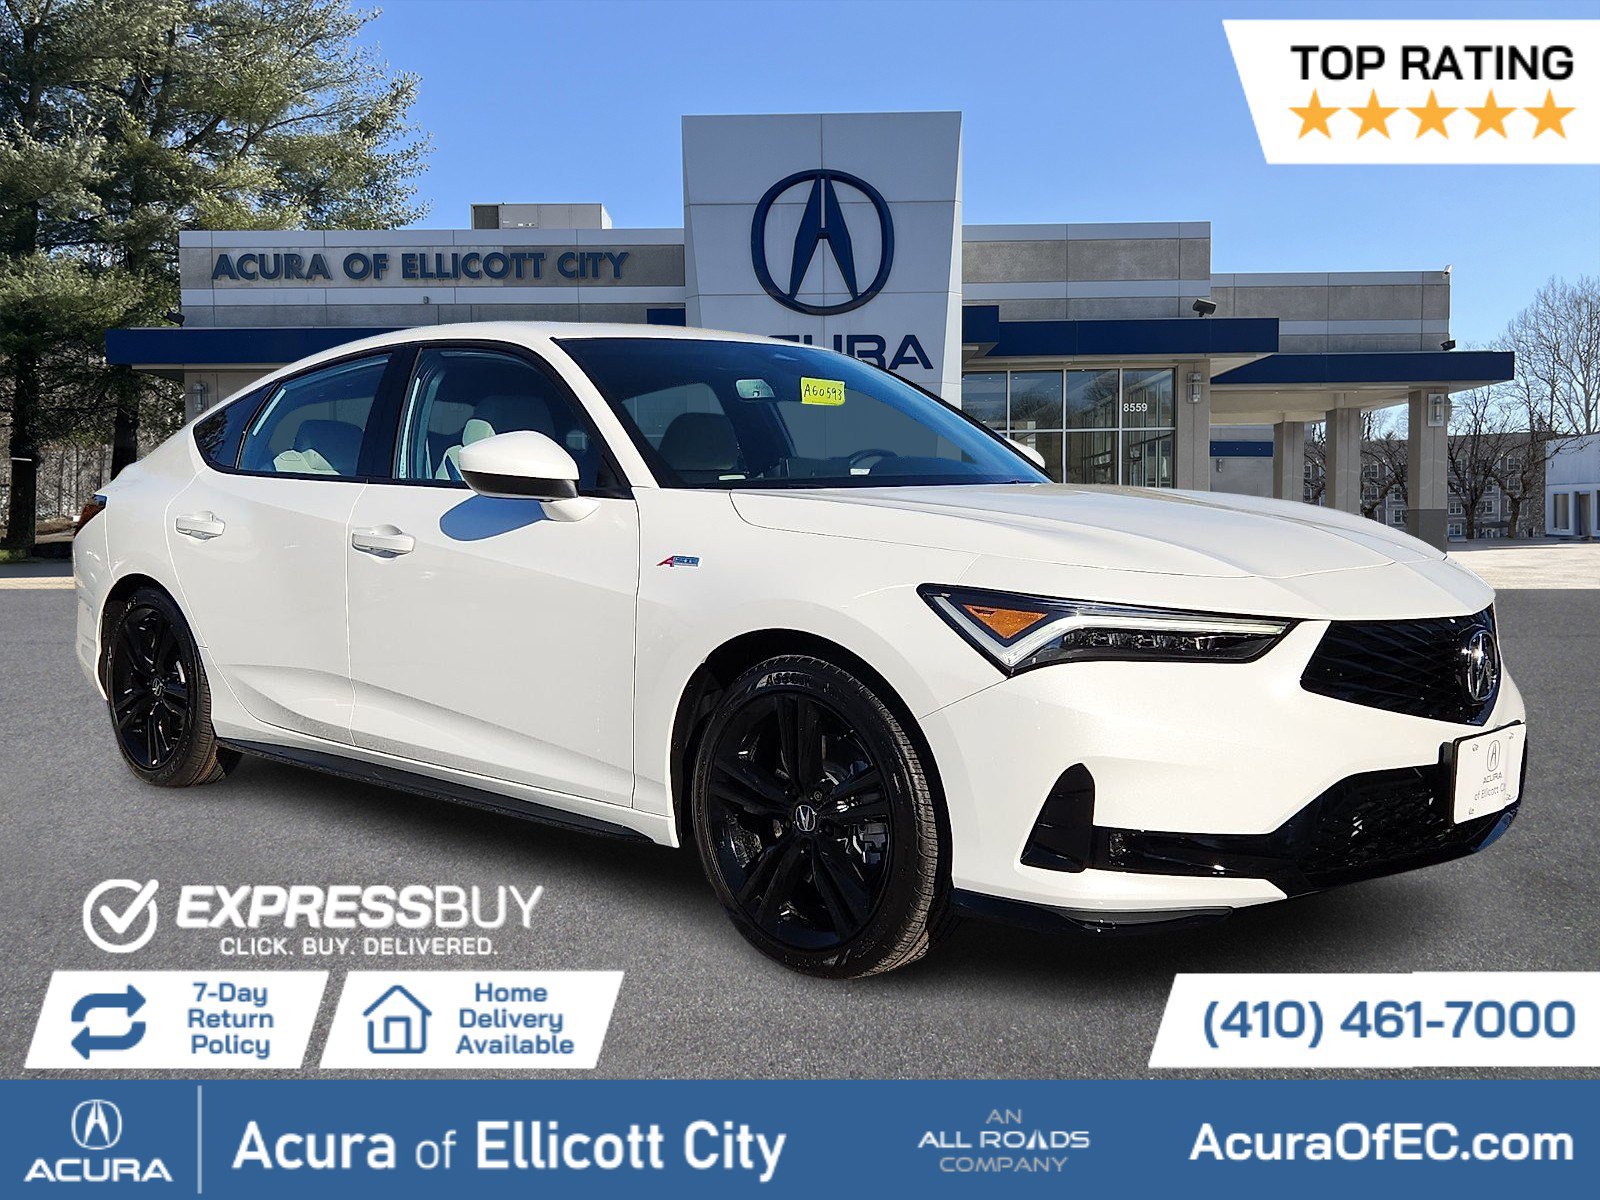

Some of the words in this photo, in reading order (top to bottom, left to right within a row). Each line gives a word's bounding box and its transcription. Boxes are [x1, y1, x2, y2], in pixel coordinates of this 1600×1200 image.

[211, 252, 333, 281] ACURA
[342, 252, 390, 280] OF
[401, 251, 546, 280] ELLICOTT
[556, 251, 630, 280] CITY
[1122, 402, 1148, 412] 8559
